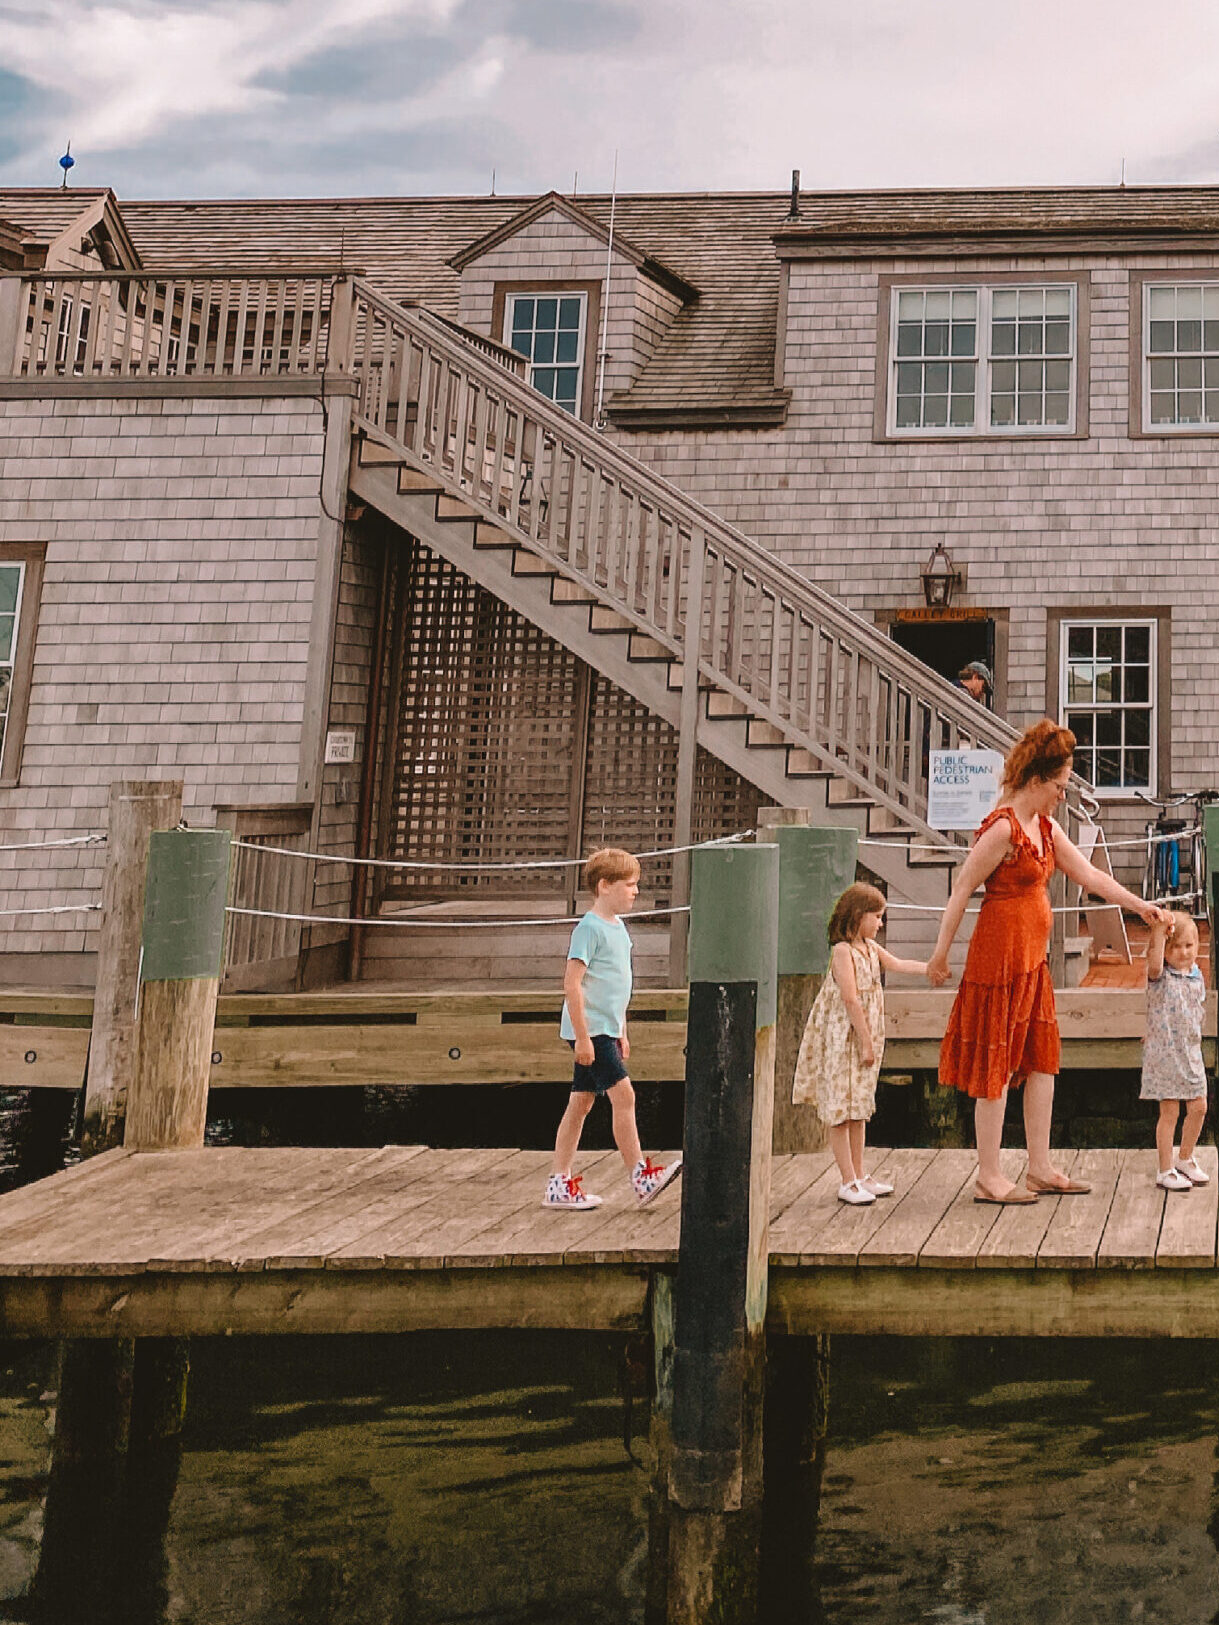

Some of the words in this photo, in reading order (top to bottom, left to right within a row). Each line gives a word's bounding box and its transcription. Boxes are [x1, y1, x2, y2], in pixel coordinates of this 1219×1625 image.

[933, 756, 968, 765] PUBLIC
[933, 765, 993, 775] PEDESTRIAN
[933, 775, 970, 785] ACCESS
